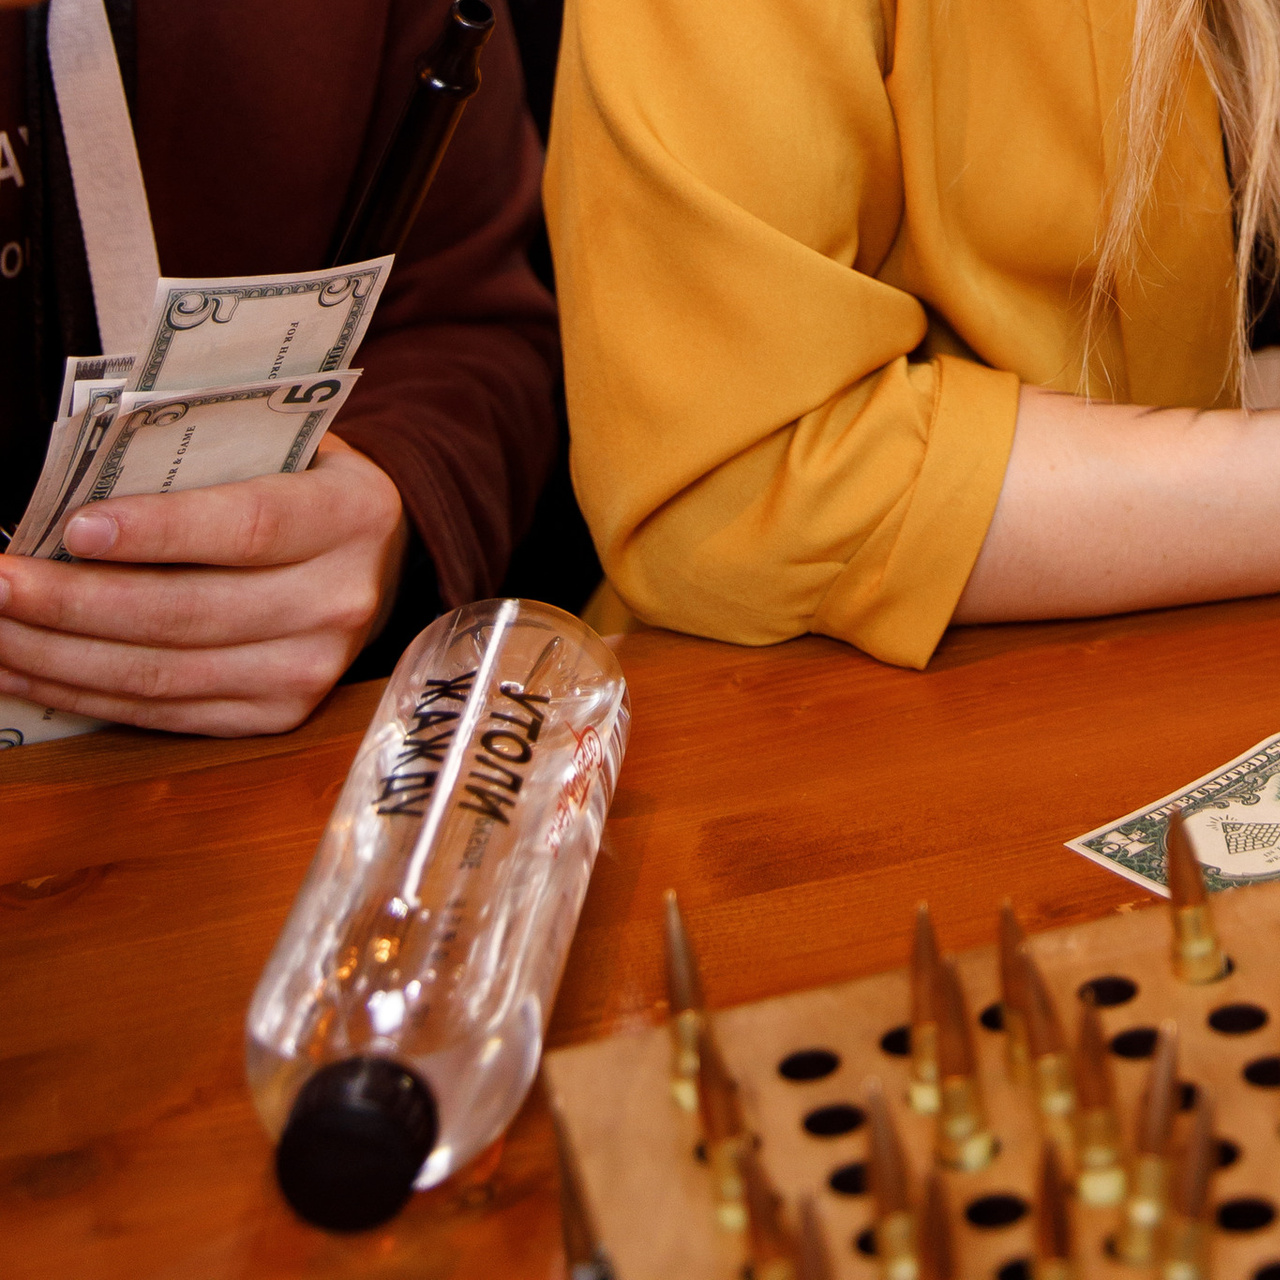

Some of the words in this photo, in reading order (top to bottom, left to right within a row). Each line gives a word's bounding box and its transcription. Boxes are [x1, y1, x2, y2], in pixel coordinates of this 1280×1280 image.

[282, 321, 300, 346] FOR
[267, 345, 288, 380] HAIRC
[281, 378, 342, 404] 5
[163, 465, 179, 488] BAR
[173, 455, 183, 466] &
[178, 425, 196, 452] GAME
[370, 669, 479, 818] ЖАЖДУ
[459, 681, 551, 827] УТОЛИ
[1195, 752, 1269, 798] UNITED
[1262, 849, 1276, 858] IN
